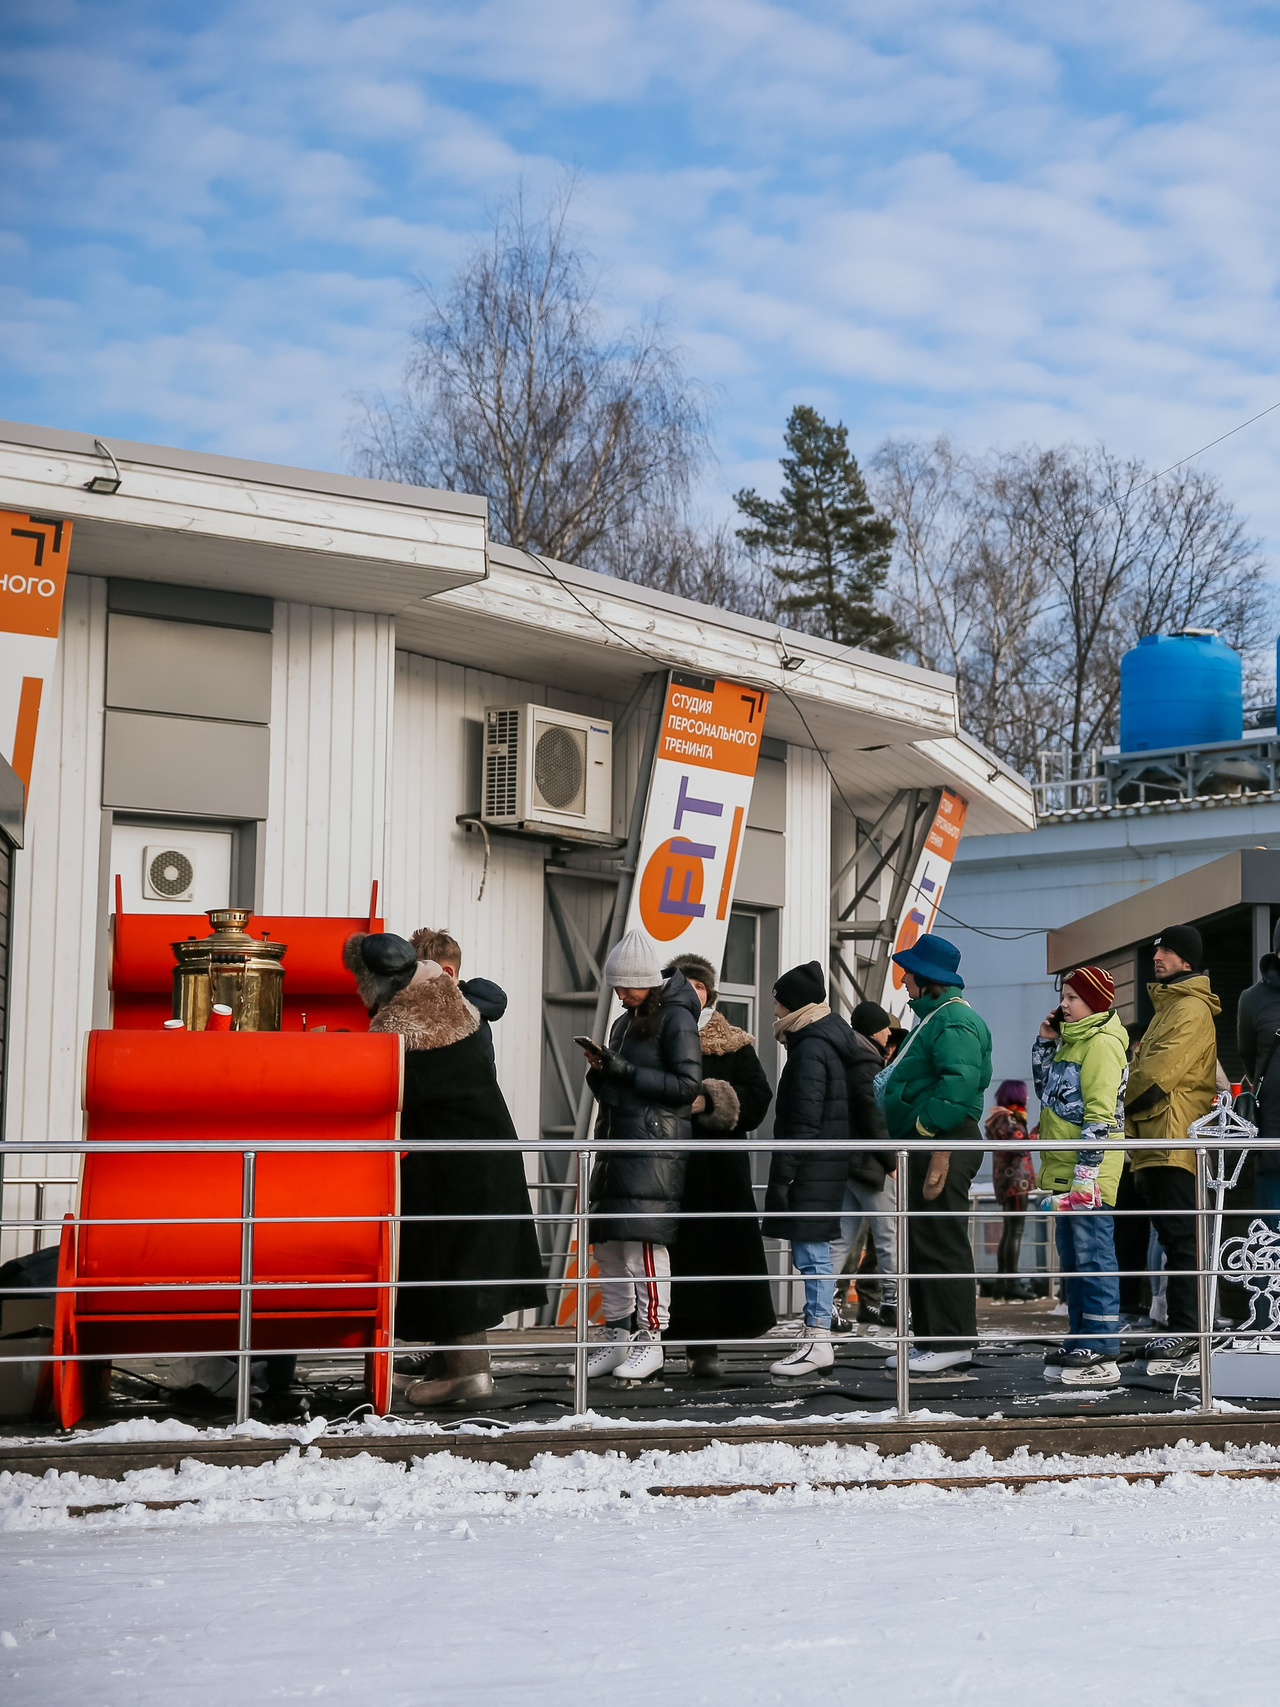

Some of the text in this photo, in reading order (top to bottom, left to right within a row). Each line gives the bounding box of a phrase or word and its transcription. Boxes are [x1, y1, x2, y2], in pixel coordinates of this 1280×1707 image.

[671, 692, 713, 715] СТУДИЯ
[667, 714, 757, 747] ПЕРСОНАЛЬНОГО
[665, 736, 713, 760] ТРЕНИНГА
[658, 775, 724, 918] FIT
